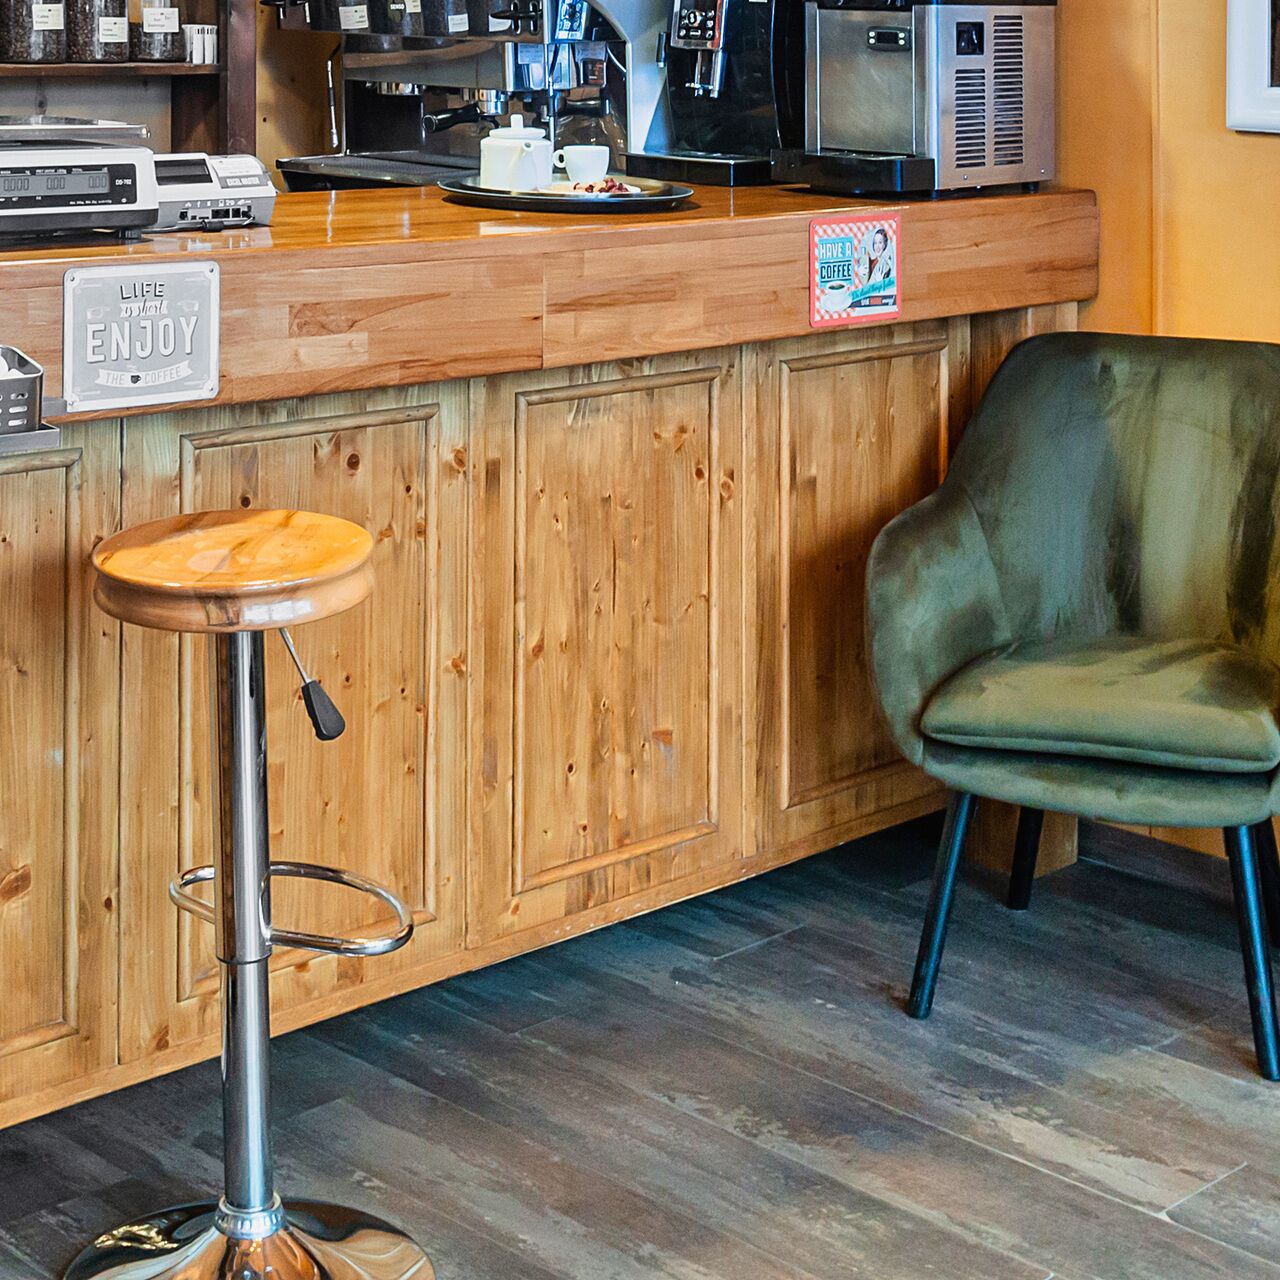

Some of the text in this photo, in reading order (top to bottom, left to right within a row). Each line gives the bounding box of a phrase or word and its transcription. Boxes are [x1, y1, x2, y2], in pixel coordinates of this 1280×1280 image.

[820, 242, 852, 259] HAVE A
[820, 263, 852, 279] COFFEE
[120, 281, 165, 300] LIFE
[125, 299, 163, 318] is short
[86, 316, 198, 364] ENJOY
[106, 365, 181, 386] THE COFFEE
